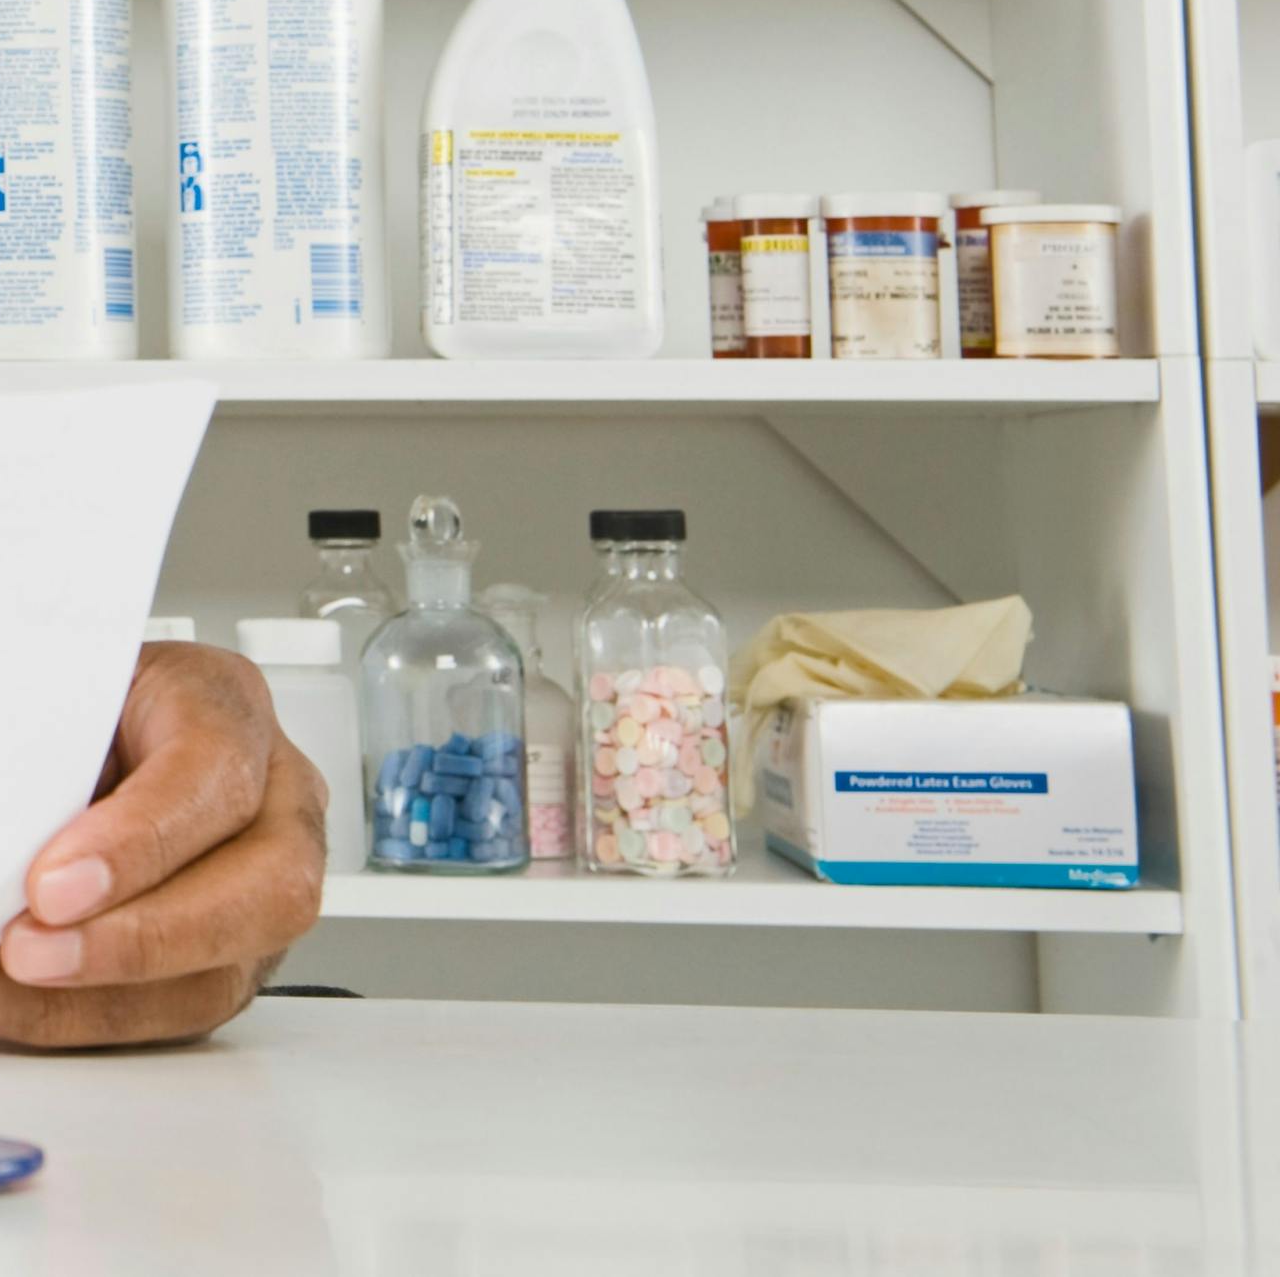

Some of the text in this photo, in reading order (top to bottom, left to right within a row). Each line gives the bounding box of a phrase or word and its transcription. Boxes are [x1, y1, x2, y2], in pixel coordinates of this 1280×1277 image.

[849, 774, 1033, 790] Powdered Latex Exam Gloves
